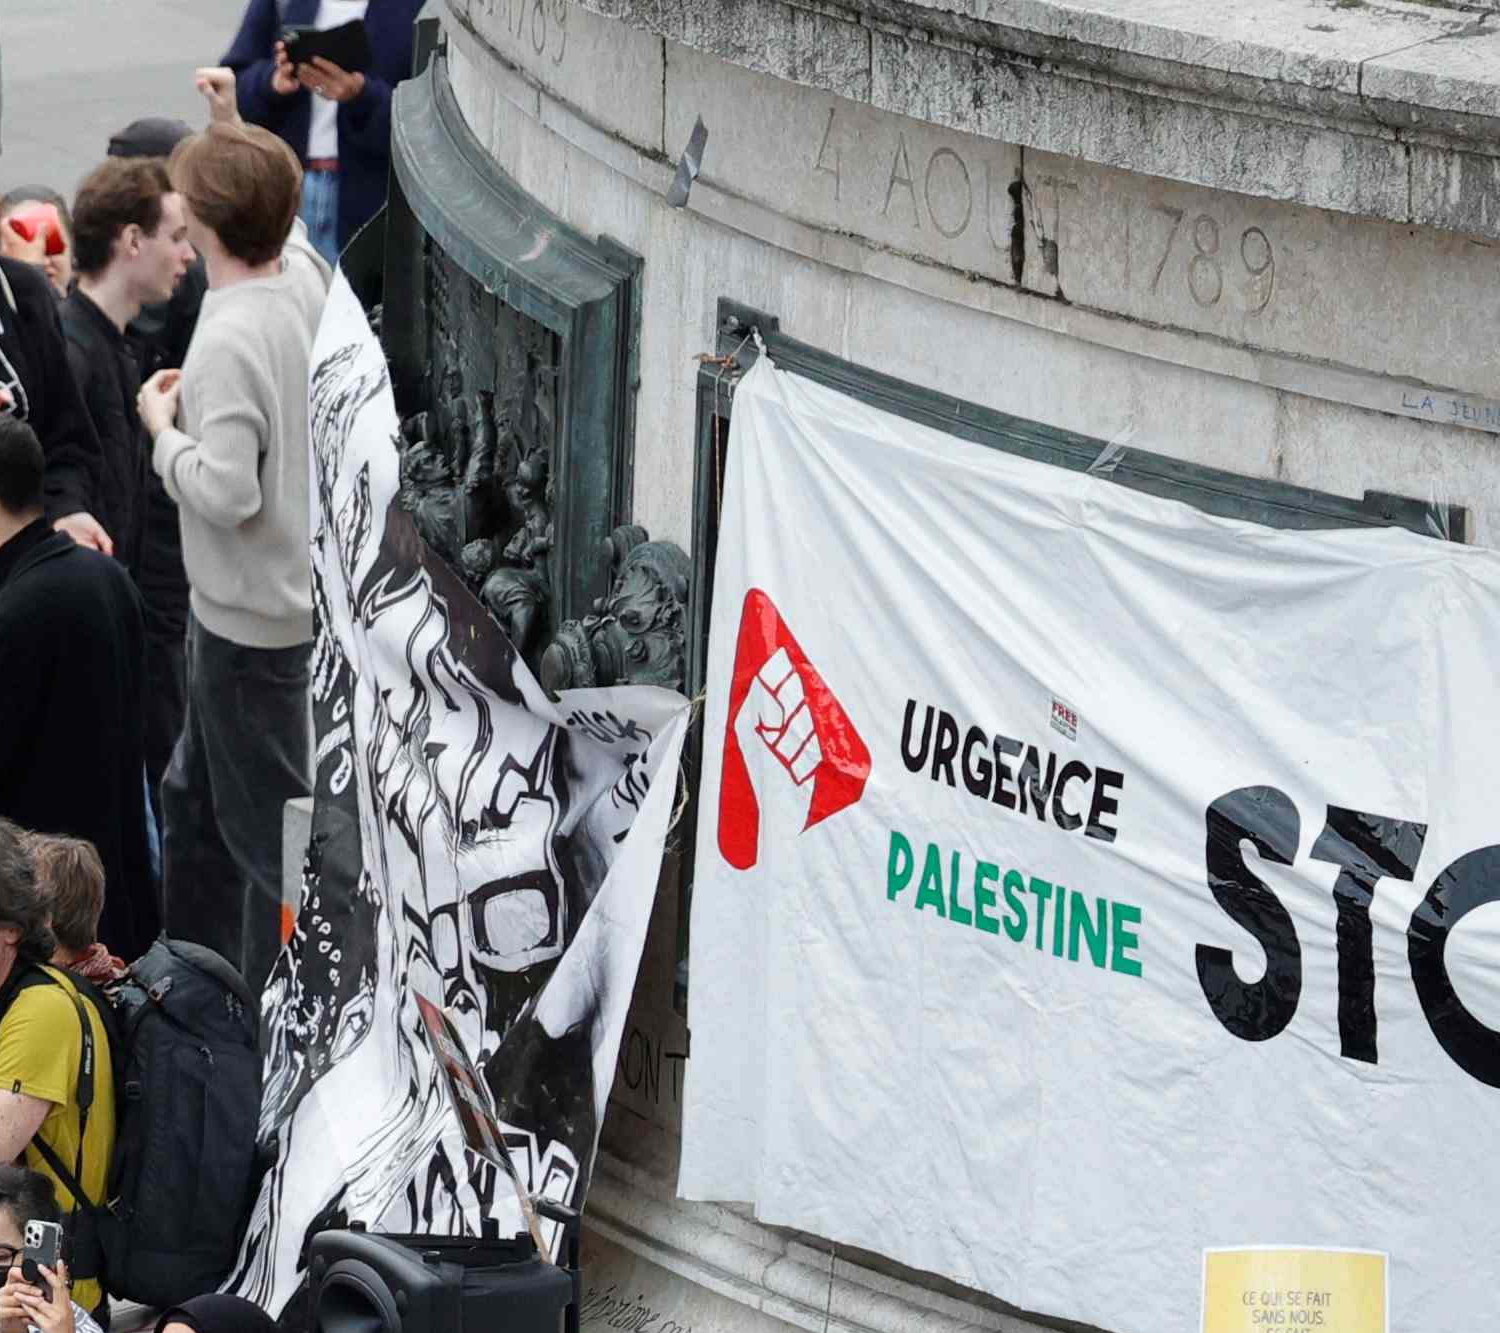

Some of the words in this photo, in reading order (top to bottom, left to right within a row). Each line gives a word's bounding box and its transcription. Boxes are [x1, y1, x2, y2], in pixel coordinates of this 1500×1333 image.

[1122, 196, 1276, 316] 1789
[900, 698, 1125, 843] URGENCE
[887, 830, 1143, 978] PALESTINE
[1242, 1291, 1257, 1306] CE
[1261, 1291, 1283, 1306] QUI
[1286, 1291, 1303, 1306] SE
[1306, 1291, 1332, 1307] FAIT
[1252, 1310, 1286, 1324] SANS
